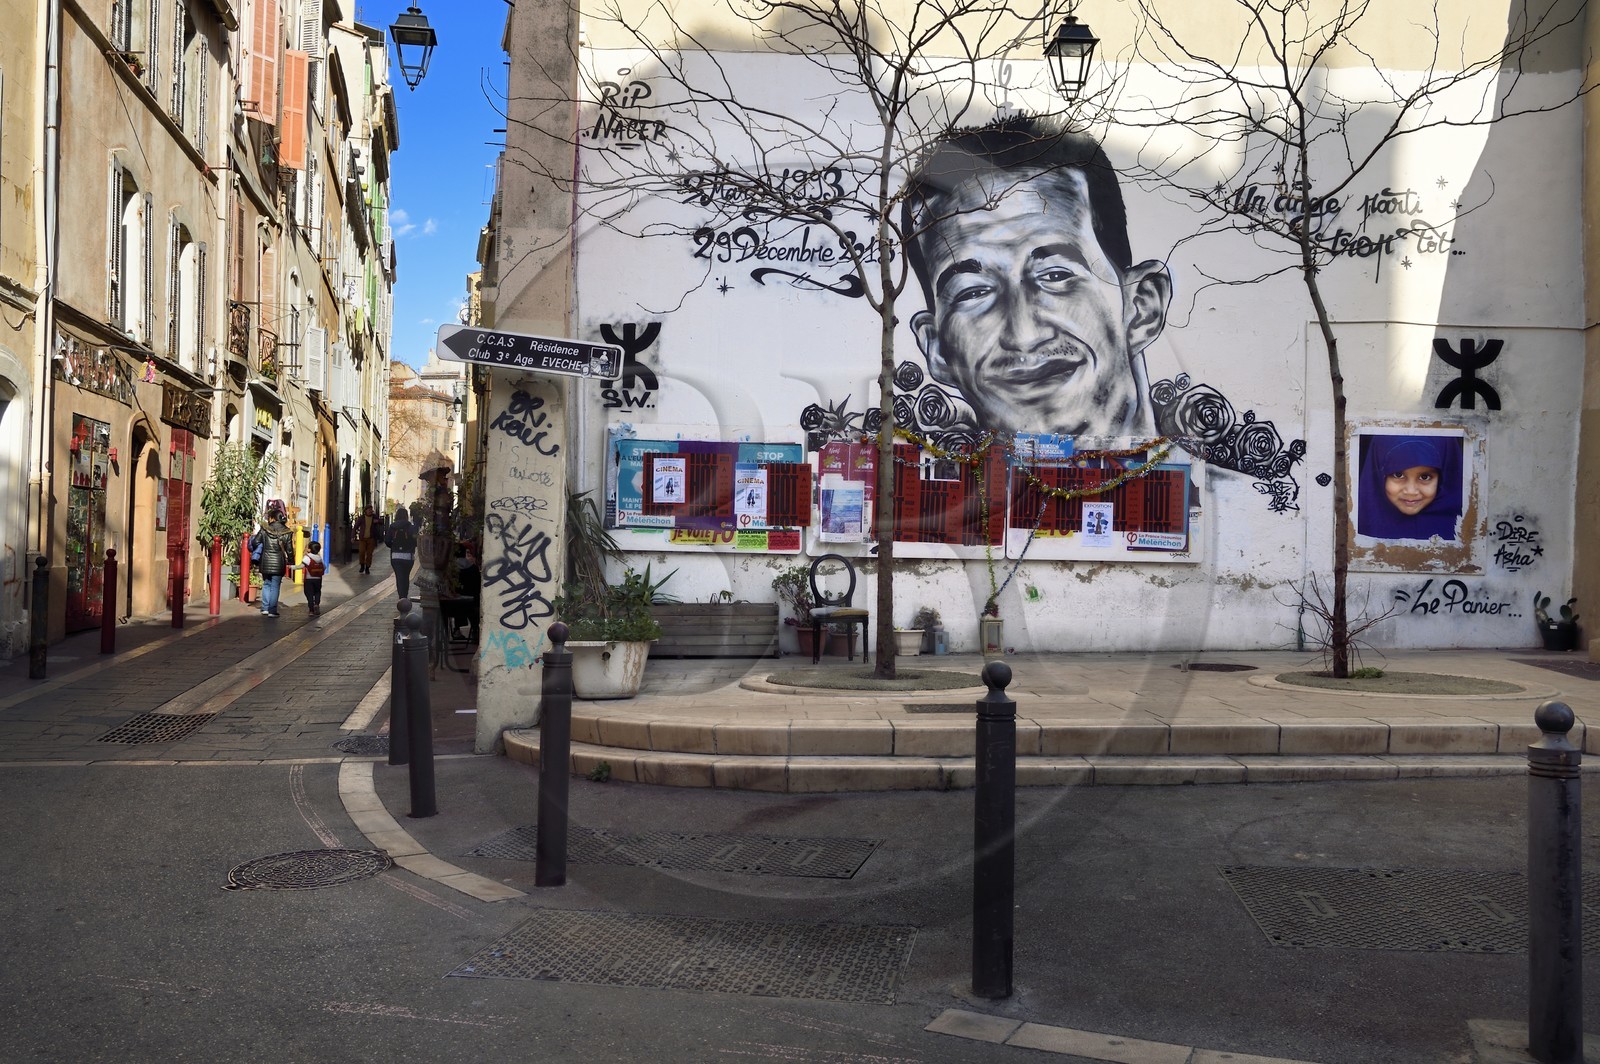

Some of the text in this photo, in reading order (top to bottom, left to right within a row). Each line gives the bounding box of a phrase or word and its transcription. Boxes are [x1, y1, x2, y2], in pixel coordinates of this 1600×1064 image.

[693, 226, 732, 263] 29
[476, 333, 580, 356] C.C.A.S Résidence
[468, 347, 491, 361] Club
[514, 353, 534, 367] Age
[541, 356, 583, 371] EVECHE
[756, 451, 784, 461] STOP
[626, 515, 671, 525] Mélenchon
[1138, 538, 1182, 547] Mélenchon
[1410, 579, 1441, 615] Le
